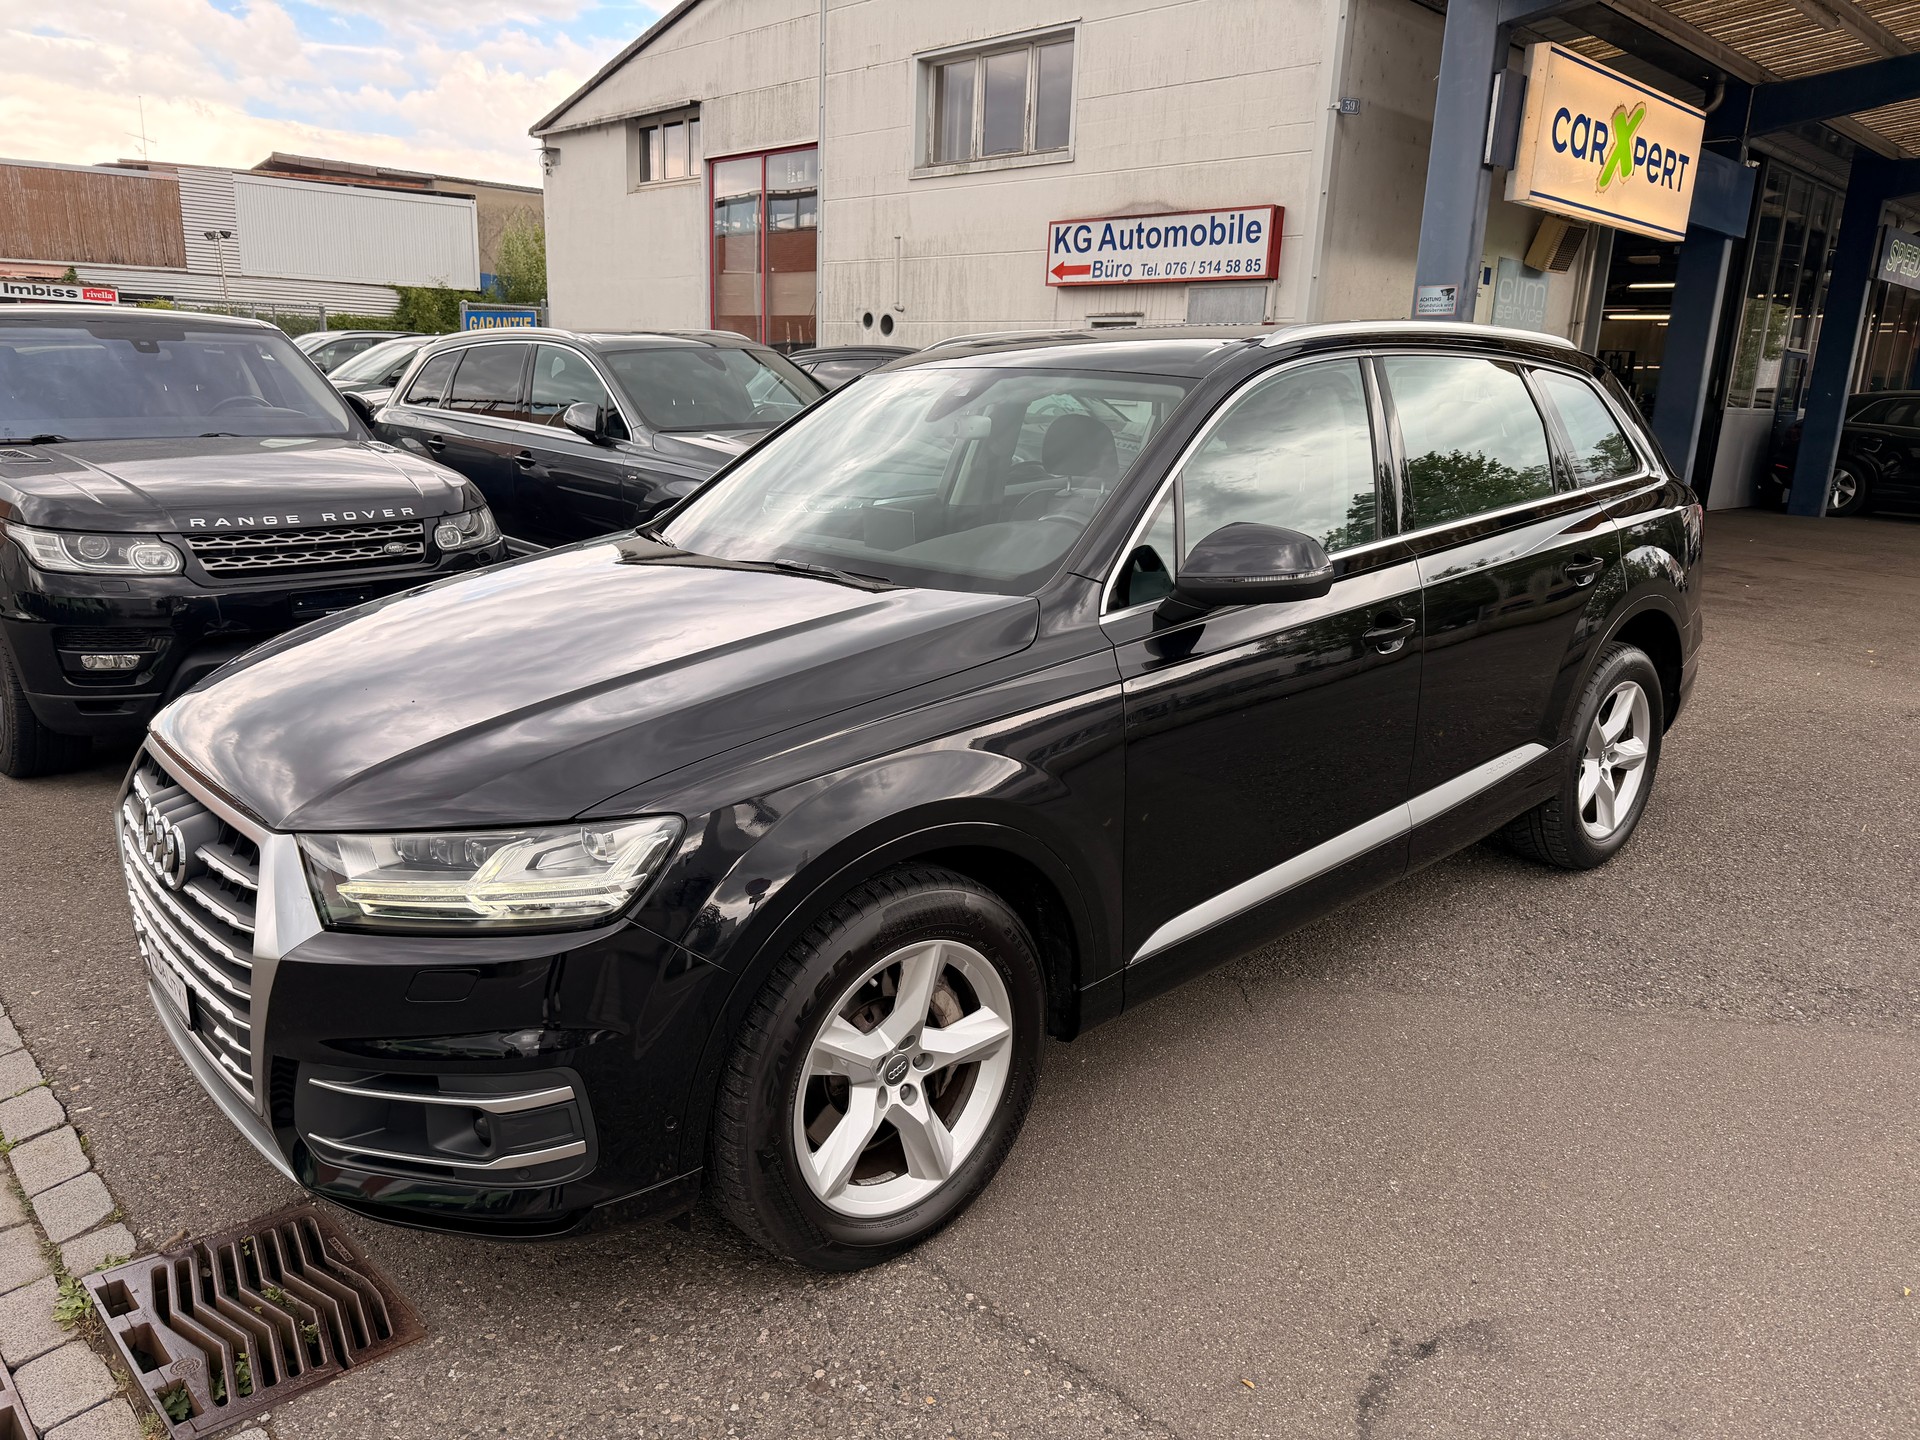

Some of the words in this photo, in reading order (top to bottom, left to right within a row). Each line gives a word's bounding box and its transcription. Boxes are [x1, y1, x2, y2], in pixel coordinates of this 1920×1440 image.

[1345, 100, 1356, 111] 39
[1054, 224, 1092, 254] KG
[1097, 213, 1262, 252] Automobile
[1092, 259, 1132, 278] Büro
[1140, 263, 1160, 276] Tel.
[1165, 261, 1187, 276] 076
[1190, 260, 1196, 275] /
[1198, 259, 1221, 275] 514
[1225, 259, 1241, 273] 58
[1245, 258, 1261, 273] 85
[3, 282, 78, 299] Imbiss
[86, 290, 114, 299] rivella
[1494, 304, 1543, 323] service
[189, 514, 301, 528] RANGE
[321, 507, 415, 522] ROVER
